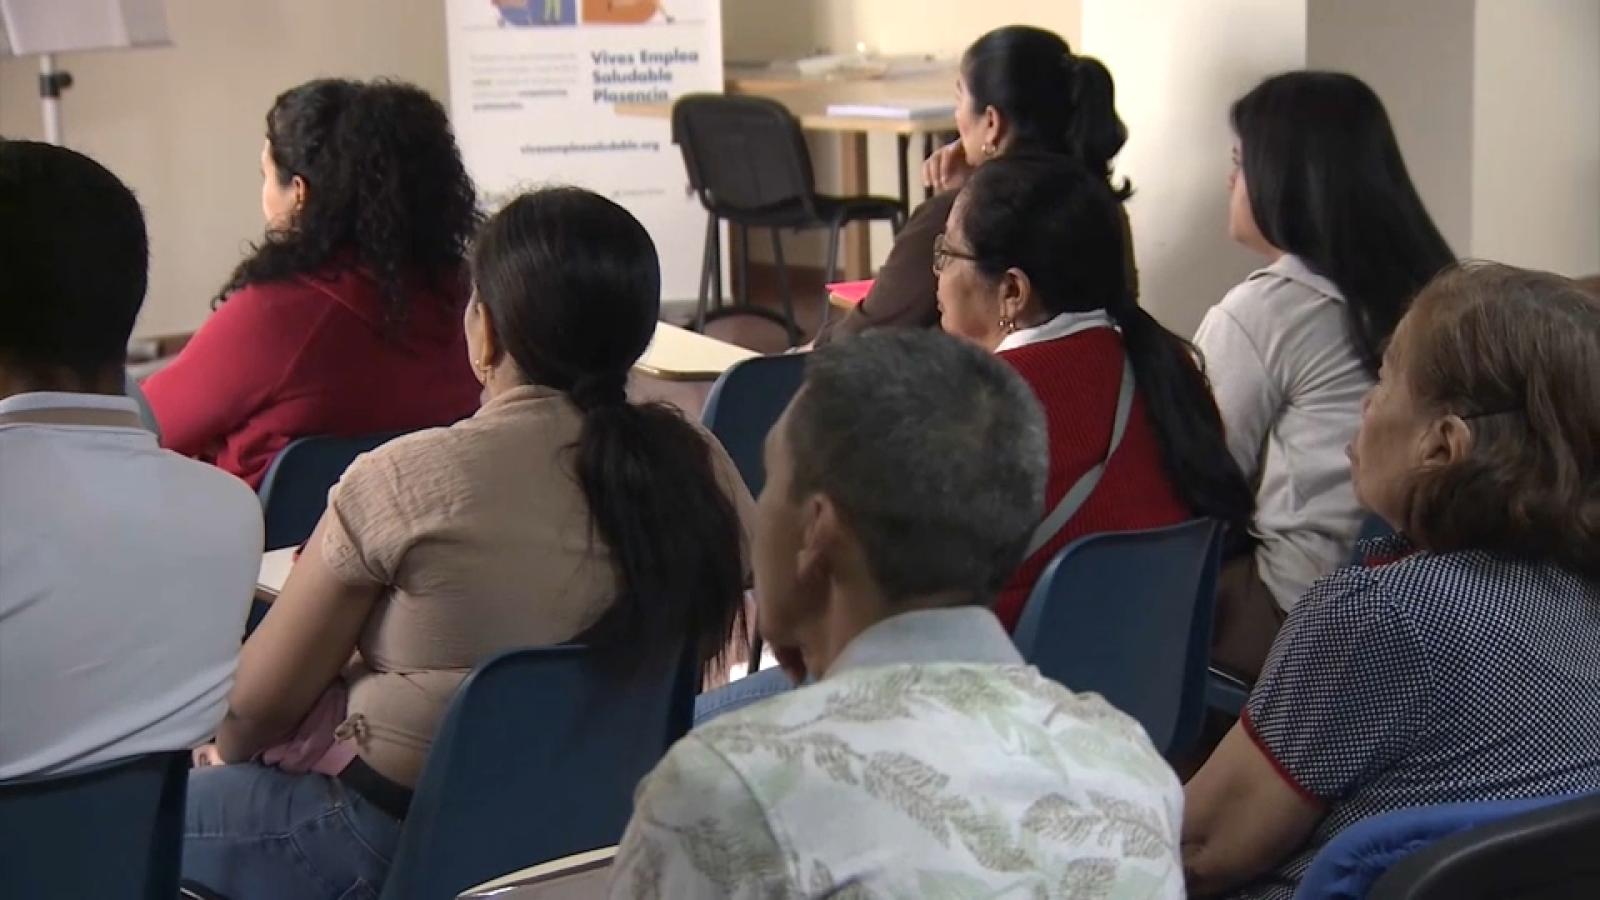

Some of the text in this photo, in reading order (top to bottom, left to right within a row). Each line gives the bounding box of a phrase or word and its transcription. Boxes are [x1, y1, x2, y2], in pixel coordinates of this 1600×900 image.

[591, 49, 635, 64] Vives
[640, 48, 699, 66] Emplea
[592, 67, 673, 83] Saludable
[592, 87, 669, 104] Plasencia
